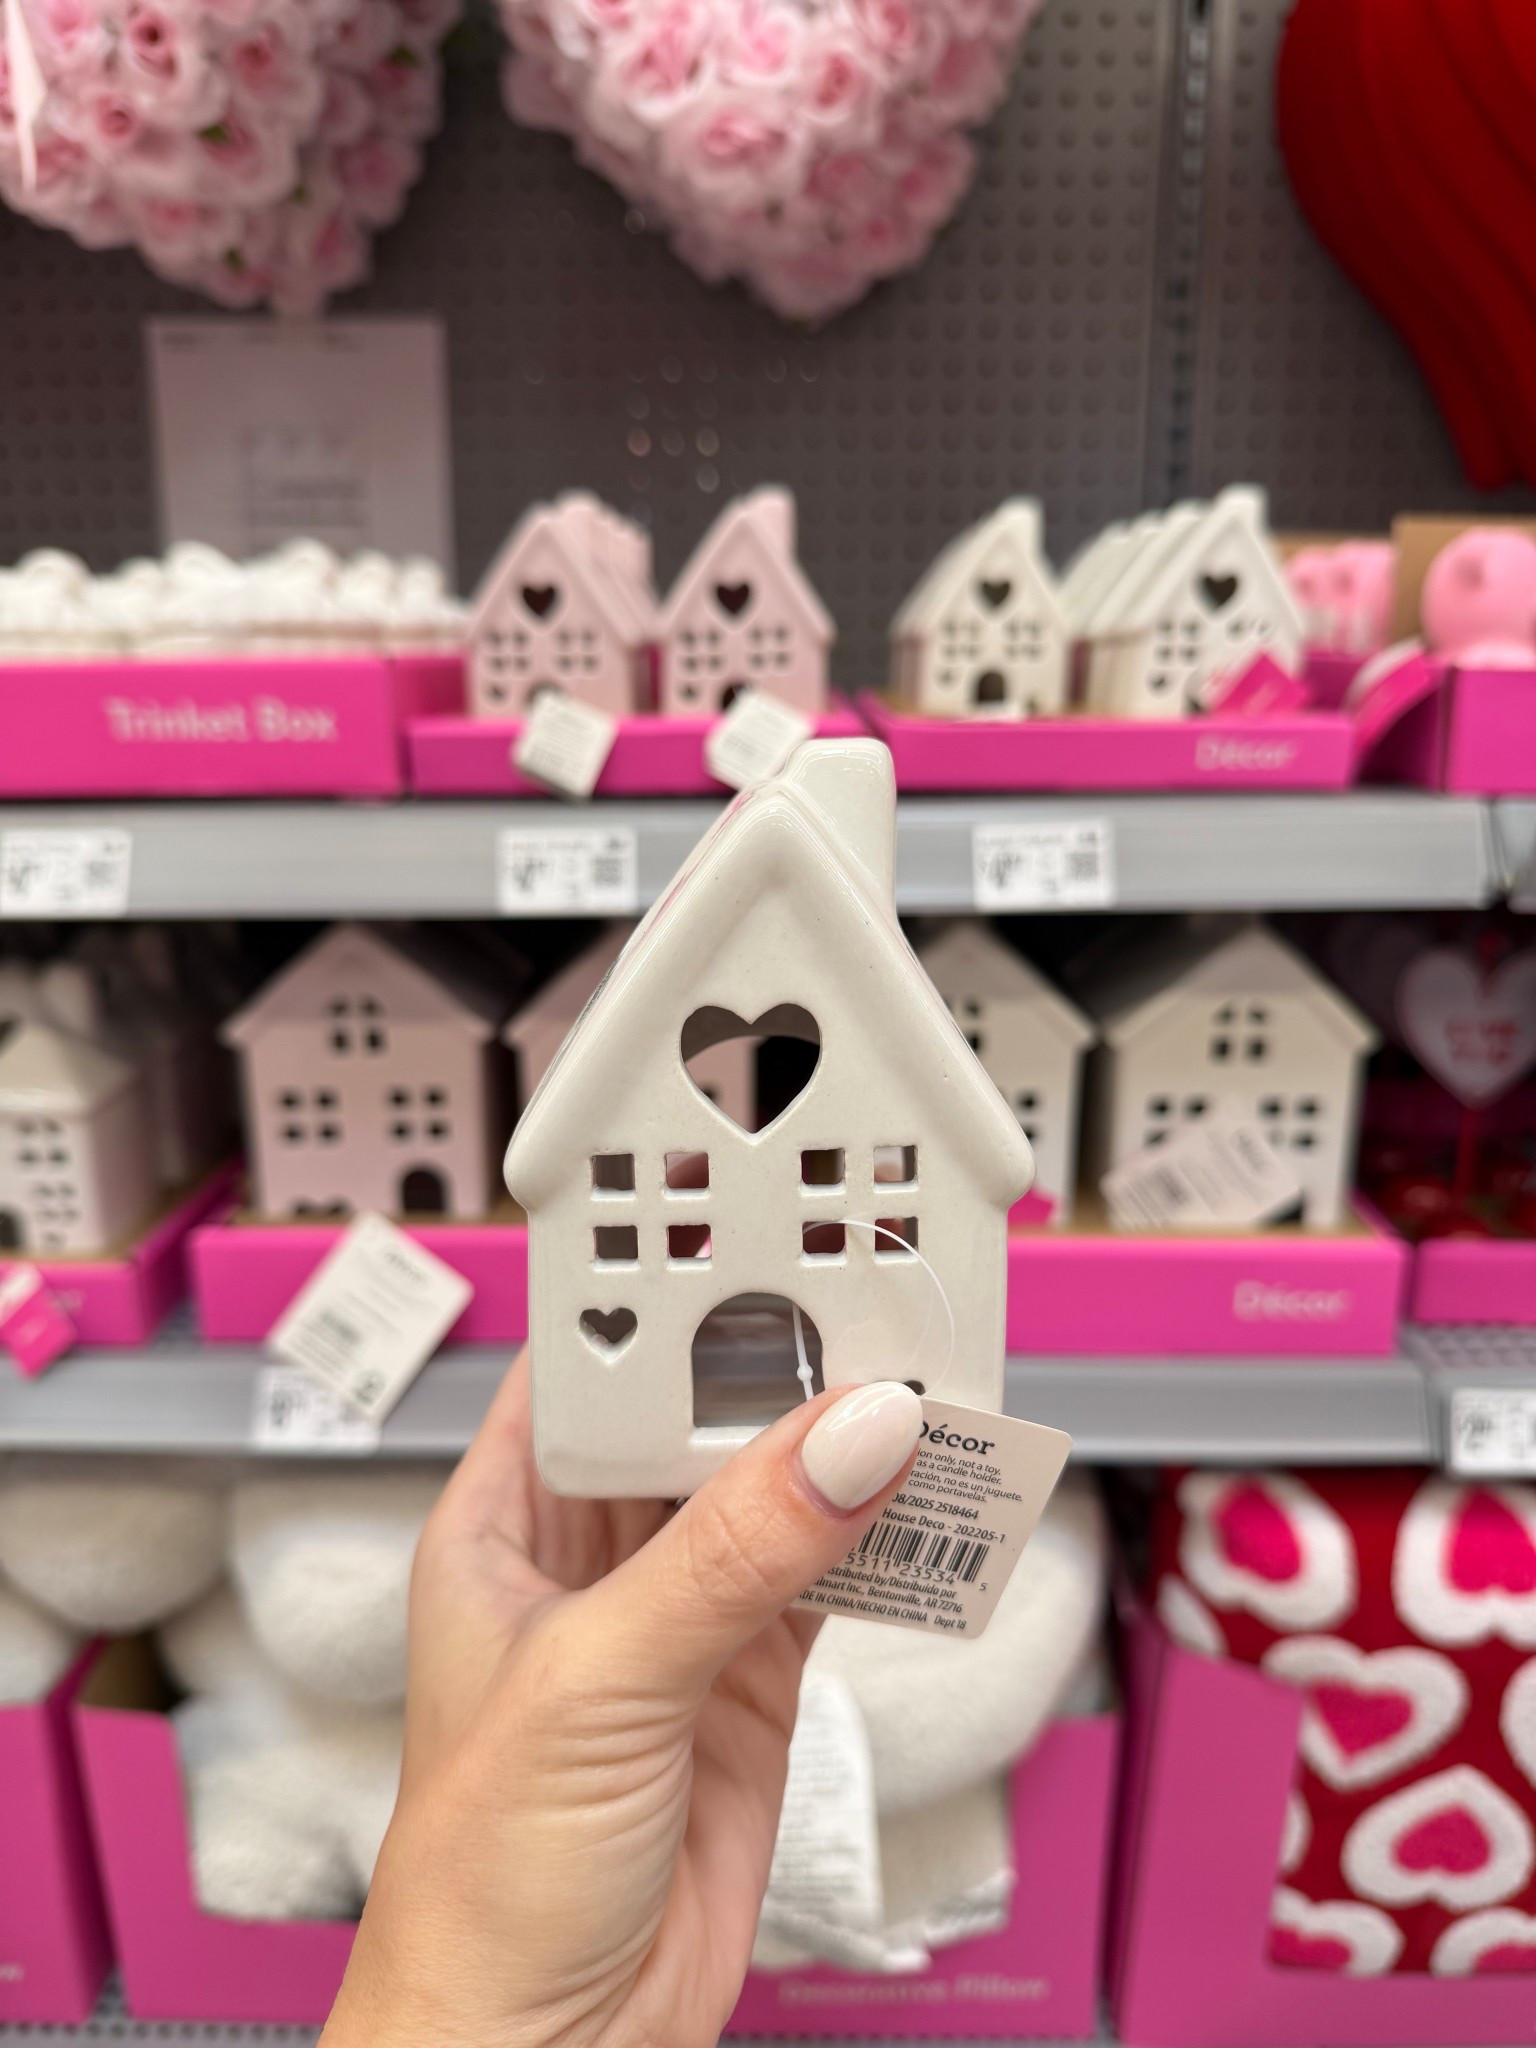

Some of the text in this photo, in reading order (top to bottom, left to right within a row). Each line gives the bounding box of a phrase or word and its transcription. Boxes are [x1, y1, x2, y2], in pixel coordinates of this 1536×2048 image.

[108, 696, 338, 741] Trinket Box
[1232, 1280, 1350, 1321] Décor
[916, 1459, 1002, 1485] as a candle holder.
[934, 1453, 956, 1466] only,
[958, 1459, 975, 1470] not
[976, 1462, 983, 1471] a
[985, 1464, 1001, 1476] toy.
[908, 1479, 987, 1503] como portavelas.
[943, 1476, 957, 1486] no
[958, 1480, 969, 1489] es
[970, 1483, 984, 1493] un
[983, 1484, 1023, 1502] juguete.
[934, 1501, 980, 1521] 2518464
[882, 1507, 917, 1524] House
[918, 1514, 945, 1531] Deco
[953, 1522, 1006, 1544] 202205-1
[874, 1573, 939, 1597] by/Distribuido
[940, 1588, 957, 1600] por
[899, 1563, 956, 1585] 23534
[978, 1582, 988, 1591] 5
[815, 1592, 827, 1604] IN
[826, 1593, 887, 1615] CHINA/HECHO
[887, 1604, 900, 1616] EN
[900, 1606, 927, 1623] CHINA
[934, 1614, 955, 1629] Dept
[956, 1619, 967, 1630] 18
[867, 1585, 922, 1607] Bentonville,
[924, 1597, 937, 1609] AR
[937, 1598, 964, 1614] 72716
